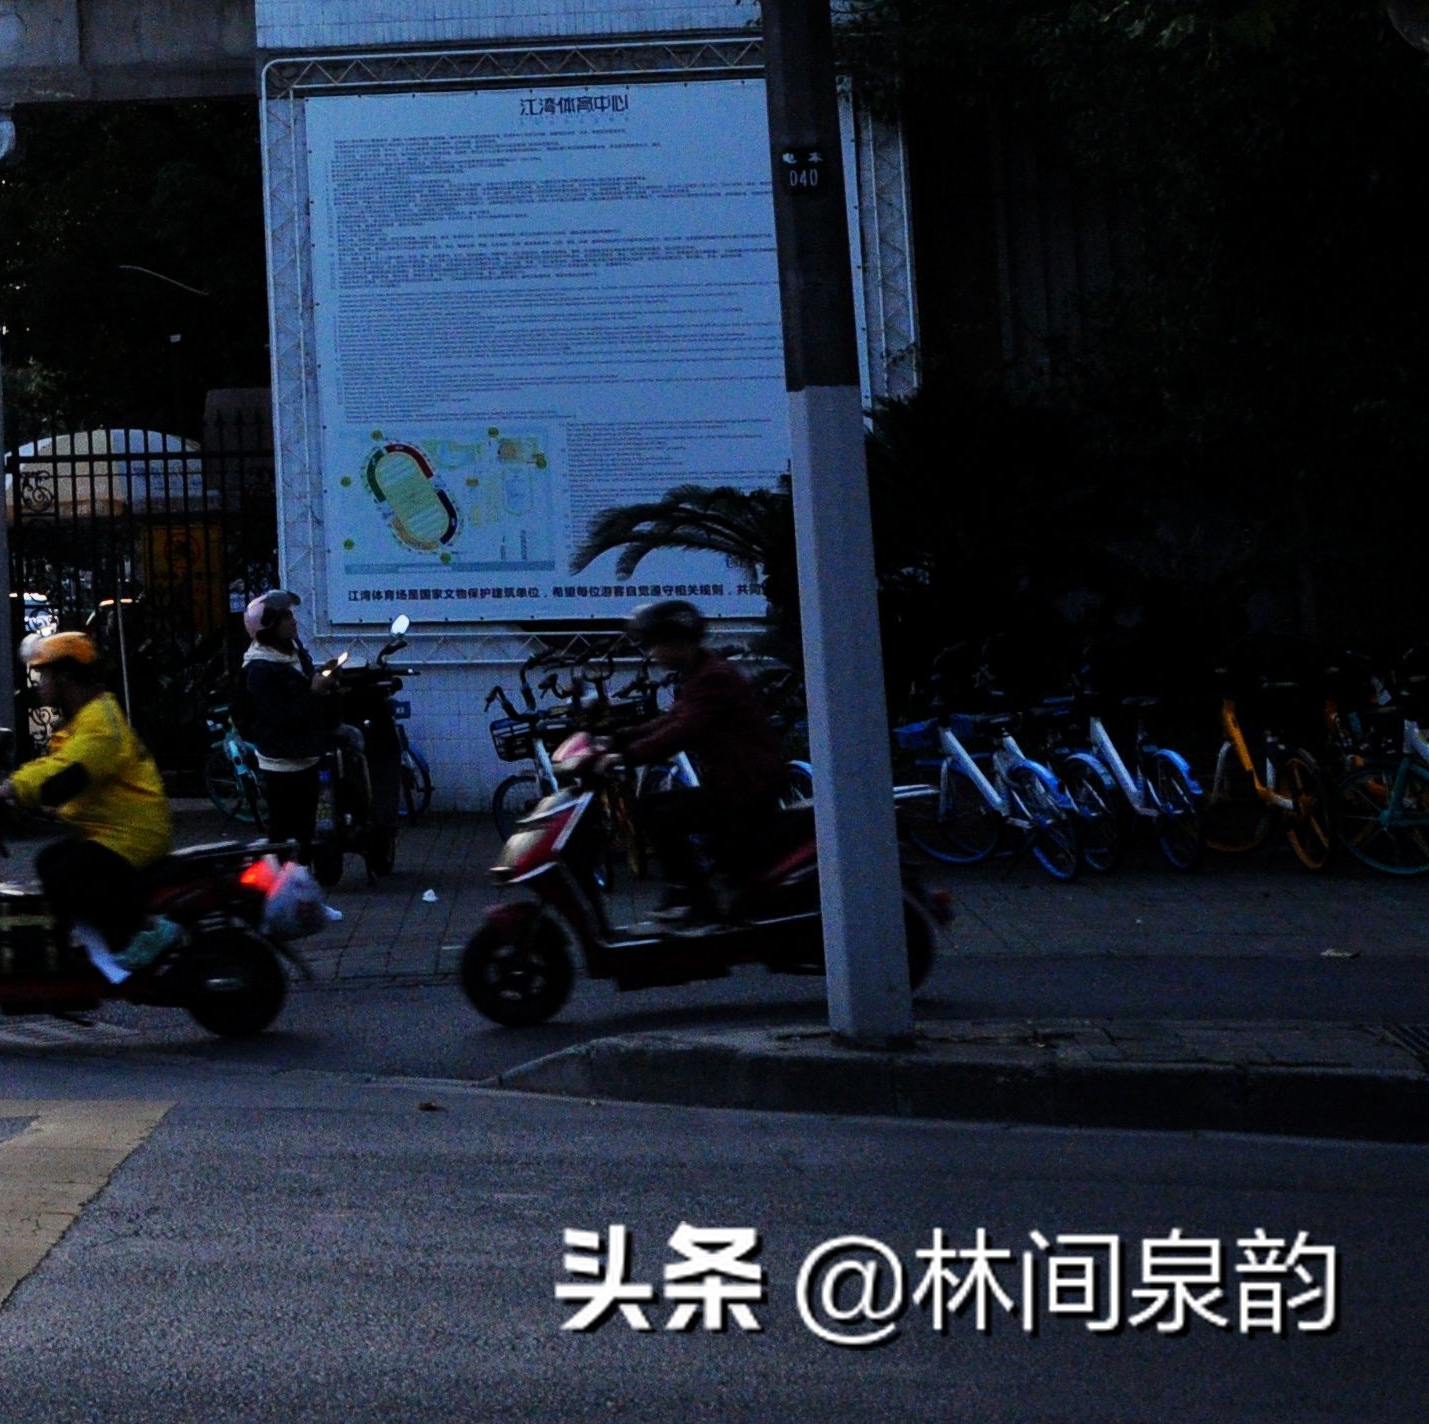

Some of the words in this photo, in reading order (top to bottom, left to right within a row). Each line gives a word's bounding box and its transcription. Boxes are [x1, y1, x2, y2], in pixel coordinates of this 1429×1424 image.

[520, 94, 629, 116] 江湾体育中心
[789, 169, 818, 187] 040
